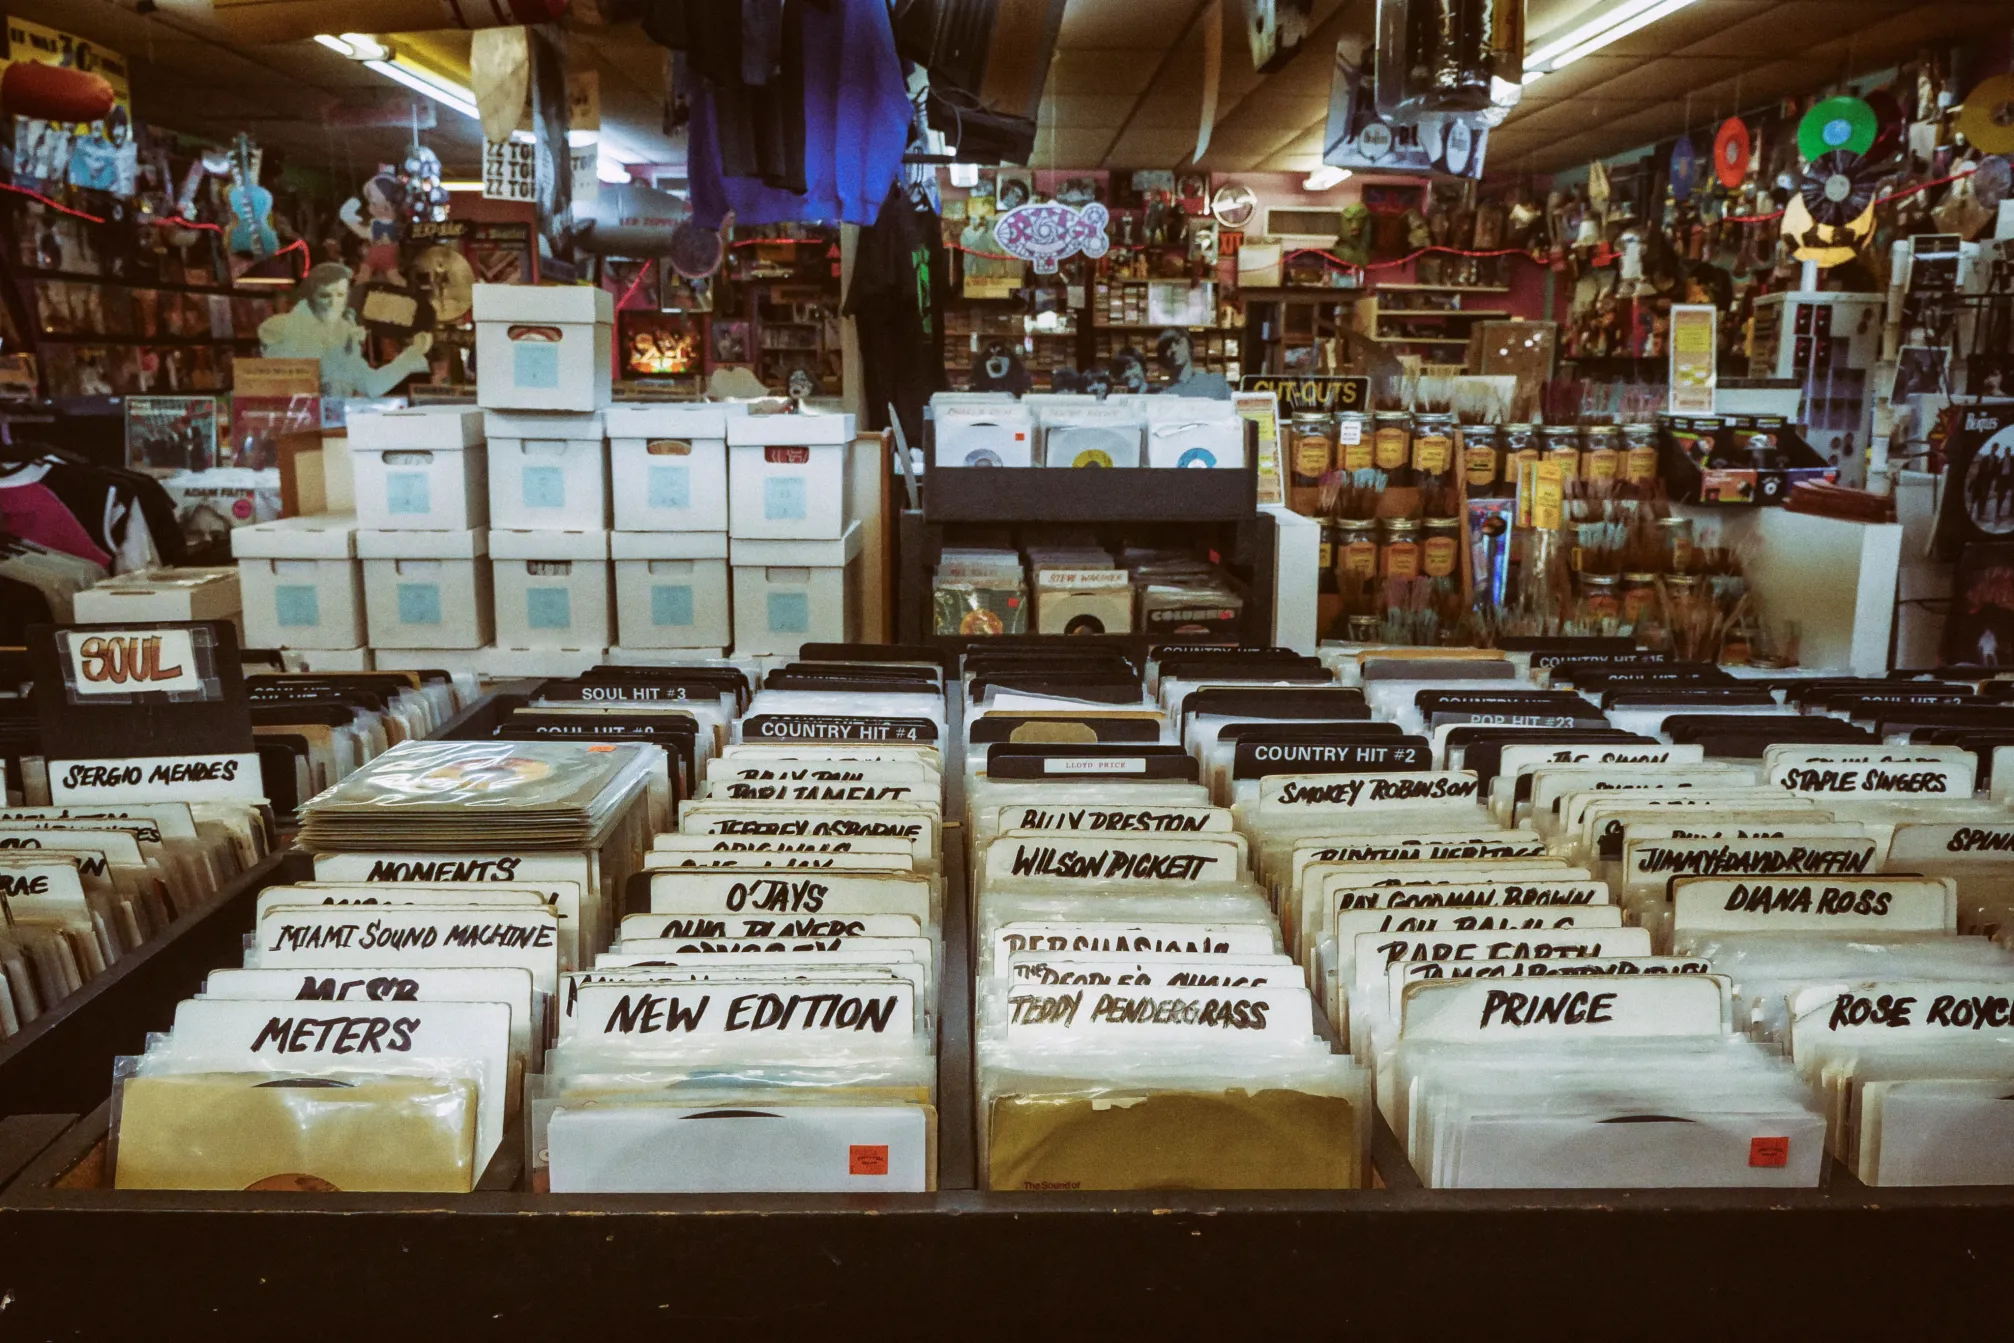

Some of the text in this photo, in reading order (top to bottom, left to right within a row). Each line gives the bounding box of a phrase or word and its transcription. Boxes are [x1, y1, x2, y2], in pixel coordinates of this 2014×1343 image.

[1151, 609, 1235, 622] COLUMB
[80, 636, 183, 684] SOUL
[582, 687, 687, 700] SOUL HIT #3
[761, 721, 918, 741] COUNTRY HIT #4
[1513, 715, 1541, 727] HIT
[1545, 716, 1575, 729] #23
[1065, 761, 1127, 769] LLOYD PRICE
[1254, 745, 1417, 764] COUNTRY HIT #2
[62, 758, 239, 789] SERGIO MENDES
[1780, 768, 1948, 793] STAPLE SINGERS
[1277, 777, 1478, 807] SMOKEY ROBINSON
[1020, 808, 1212, 833] BILLY PRESTON
[365, 857, 522, 882] MOMENTS
[1011, 844, 1219, 881] WILSON PICKETT
[726, 879, 829, 913] O'JAYS
[1504, 886, 1597, 906] BROWN
[1723, 883, 1893, 916] DIANA ROSS
[267, 918, 557, 952] MIAMI SOUND MACHINE
[603, 992, 899, 1035] NEW EDITION
[1007, 988, 1270, 1030] TEDDY PENDERGRASS
[1479, 989, 1619, 1030] PRINCE
[1828, 993, 1918, 1032] ROSE
[250, 1016, 422, 1055] METERS
[1024, 1181, 1040, 1190] The
[1041, 1181, 1070, 1190] Sound
